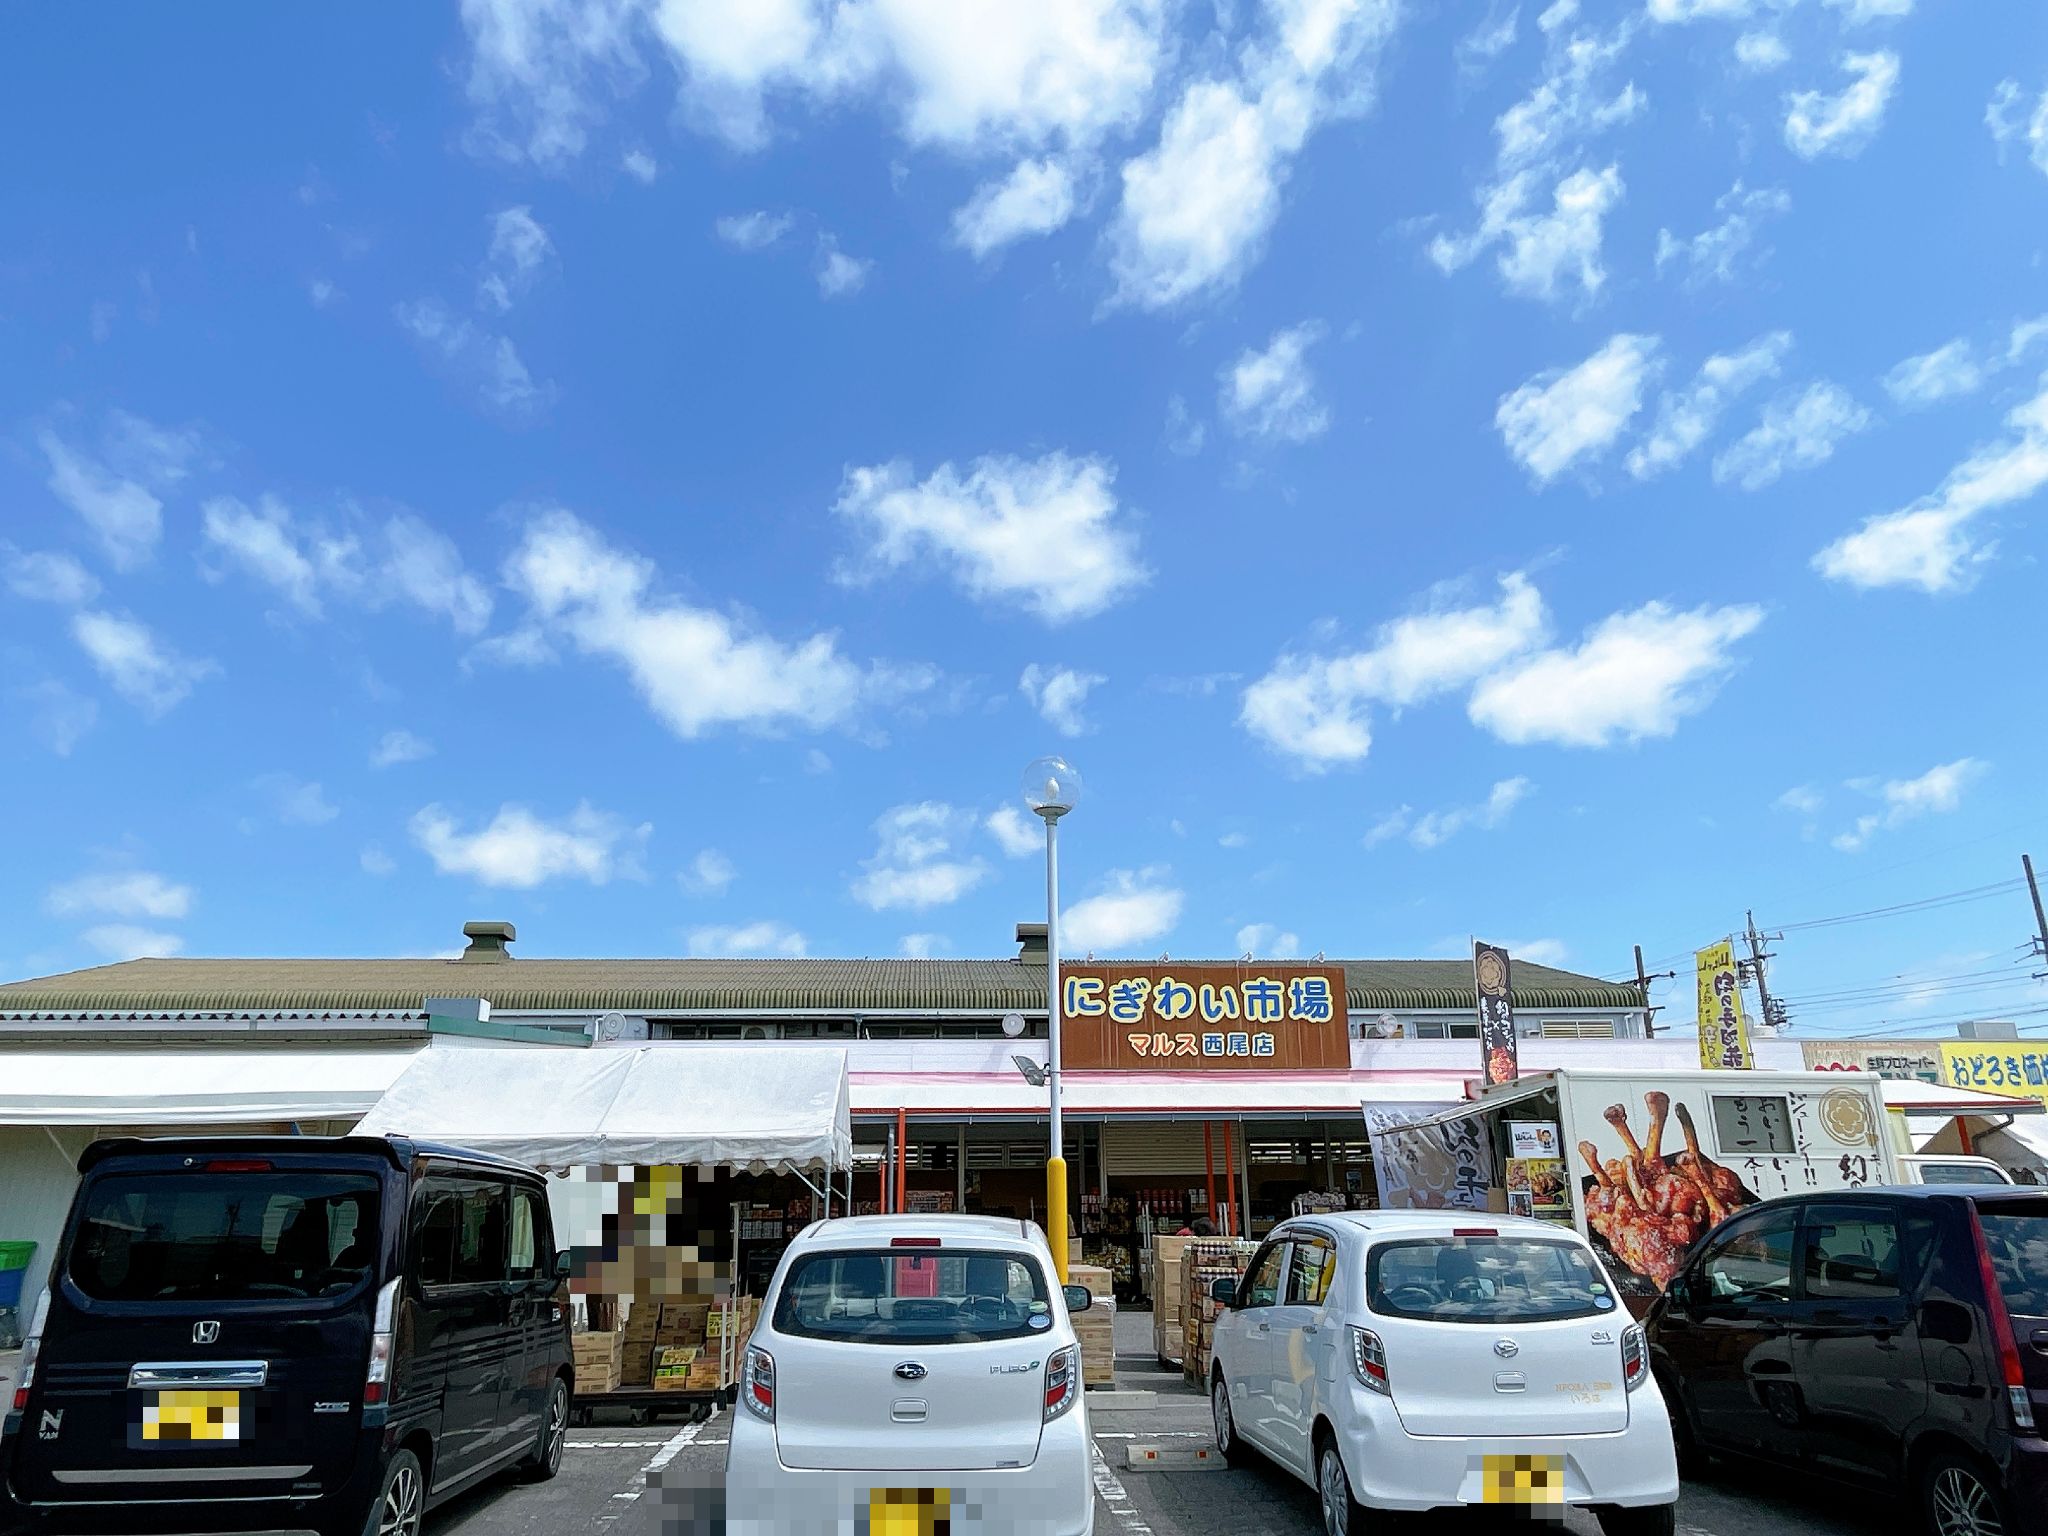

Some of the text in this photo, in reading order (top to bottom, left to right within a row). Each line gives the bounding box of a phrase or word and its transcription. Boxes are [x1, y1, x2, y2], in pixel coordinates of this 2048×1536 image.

[1064, 976, 1333, 1023] にぎわい市場
